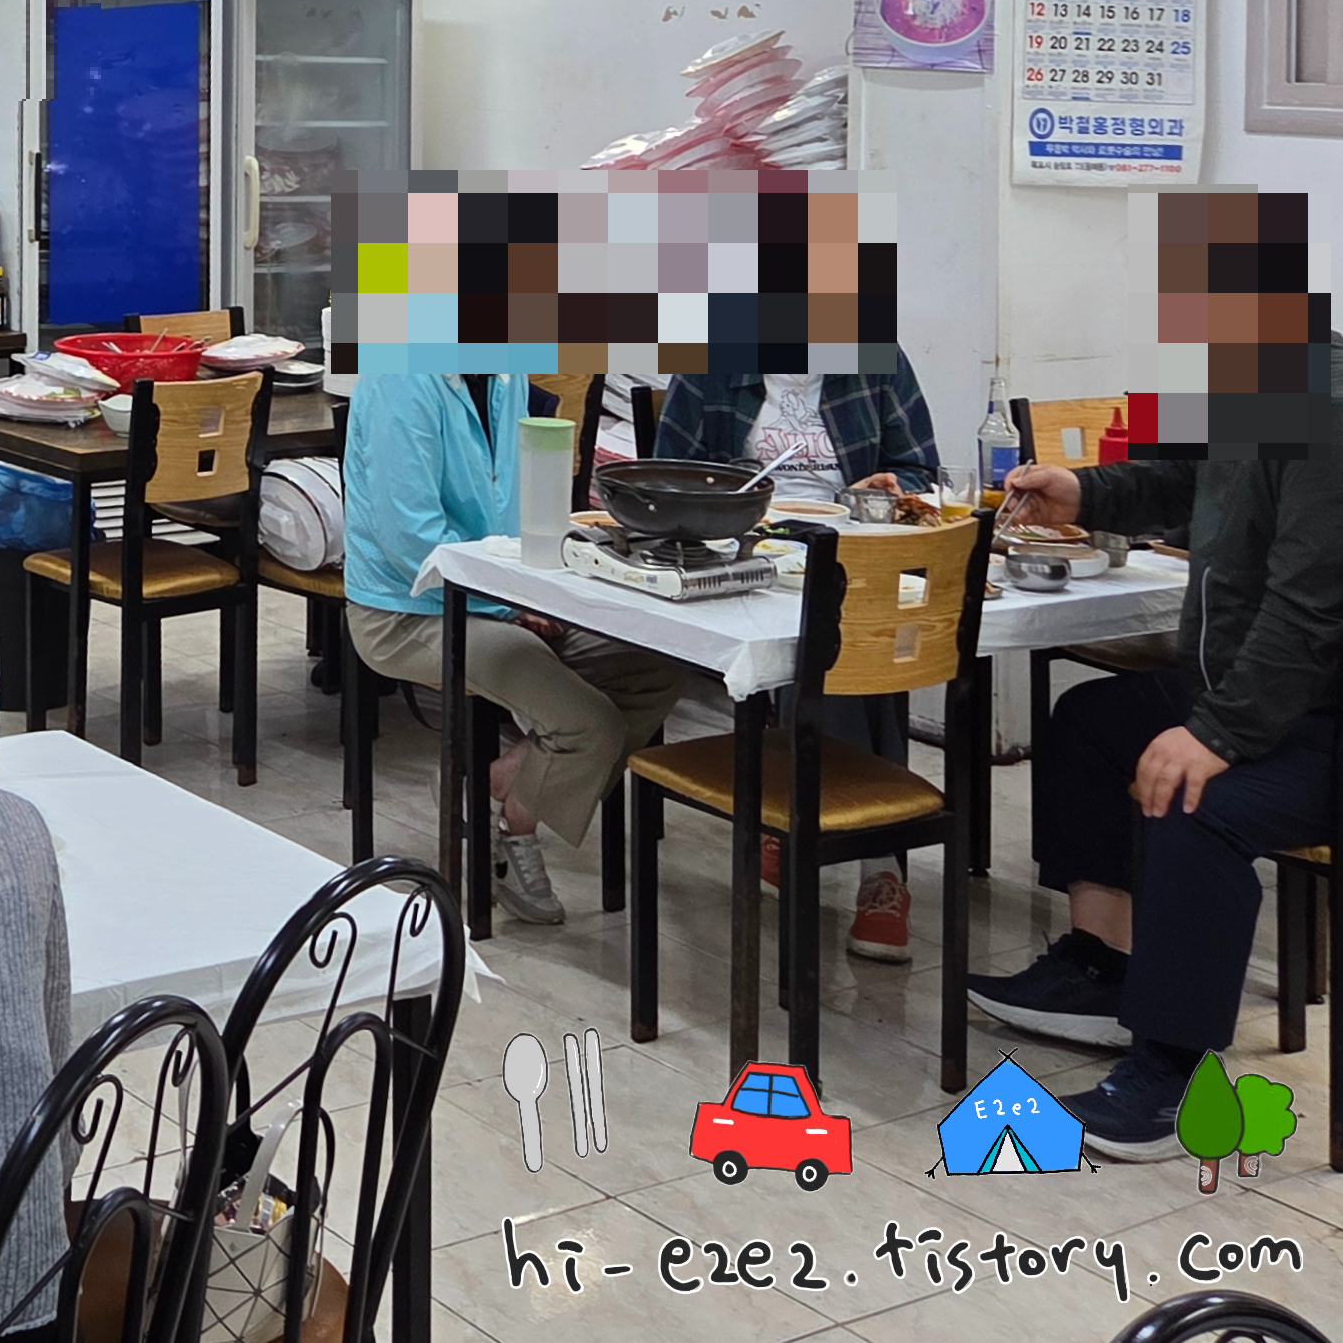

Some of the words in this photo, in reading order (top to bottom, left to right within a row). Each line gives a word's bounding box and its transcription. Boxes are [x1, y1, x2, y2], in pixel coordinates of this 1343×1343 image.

[1029, 2, 1045, 17] 12
[1053, 4, 1068, 18] 13
[1076, 5, 1092, 19] 14
[1099, 5, 1116, 20] 15
[1123, 7, 1140, 21] 16
[1148, 7, 1165, 22] 17
[1173, 9, 1191, 23] 18
[1028, 35, 1044, 49] 19
[1050, 35, 1068, 51] 20
[1074, 37, 1090, 51] 21
[1097, 37, 1115, 53] 22
[1121, 38, 1140, 53] 23
[1146, 40, 1165, 55] 24
[1171, 41, 1191, 56] 25
[1027, 68, 1044, 81] 26
[1049, 69, 1066, 83] 27
[1072, 70, 1090, 84] 28
[1096, 70, 1114, 85] 29
[1120, 71, 1139, 86] 30
[1145, 72, 1162, 86] 31
[1058, 115, 1185, 137] 박철홍정형외과
